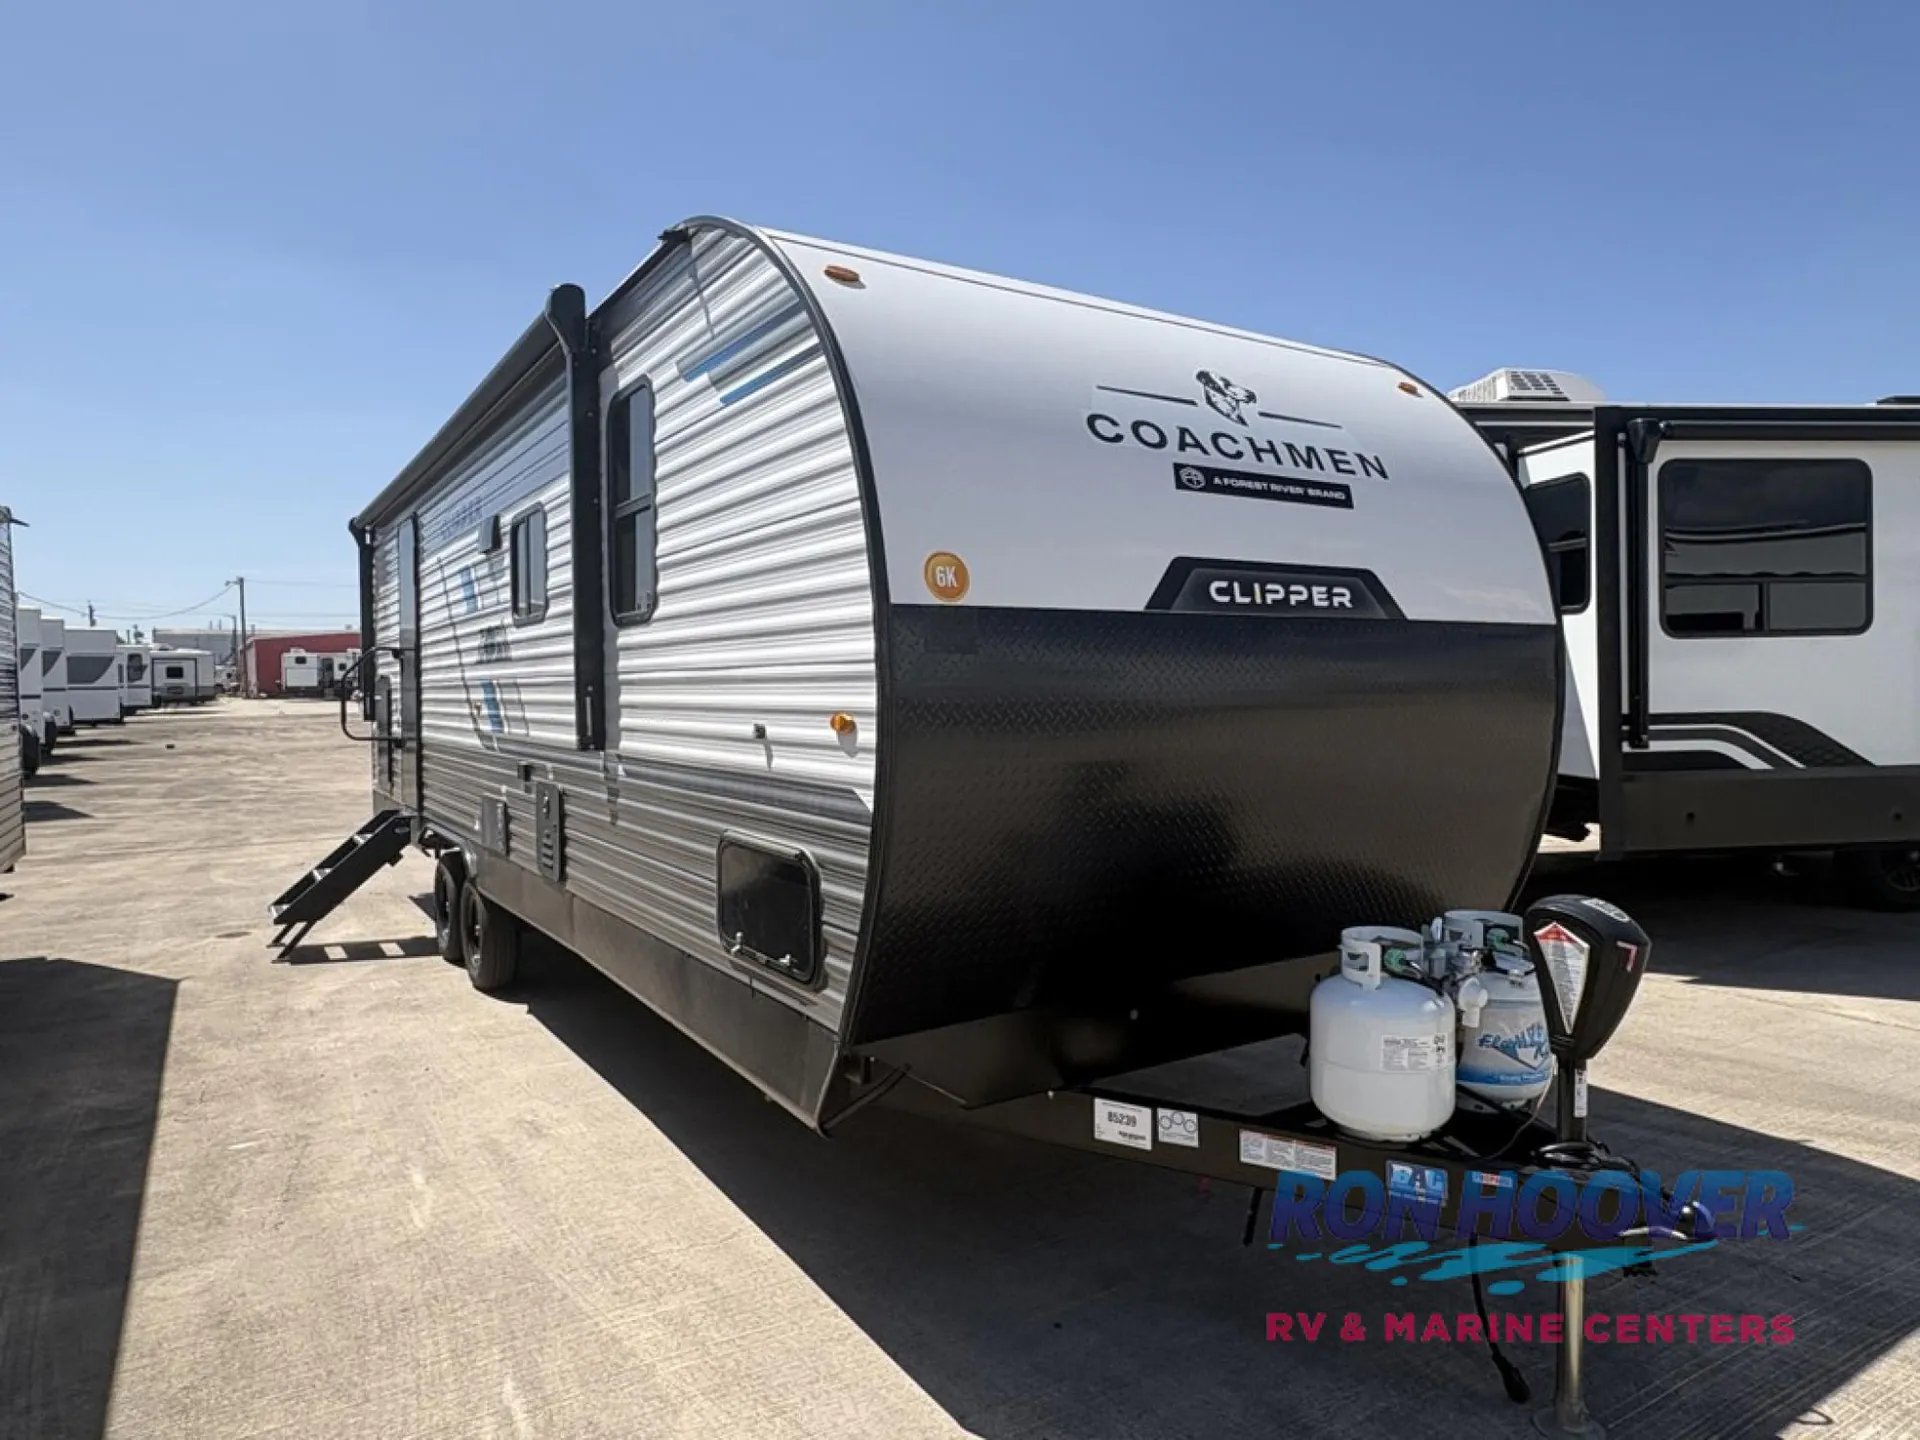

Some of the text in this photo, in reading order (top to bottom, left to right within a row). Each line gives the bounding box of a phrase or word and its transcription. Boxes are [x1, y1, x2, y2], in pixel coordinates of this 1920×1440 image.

[1086, 413, 1389, 480] COACHMEN
[1223, 478, 1268, 491] FOREST
[1270, 483, 1306, 496] RIVER
[1308, 488, 1346, 500] BRAND
[935, 565, 957, 588] 6K
[1208, 580, 1353, 608] CLIPPER
